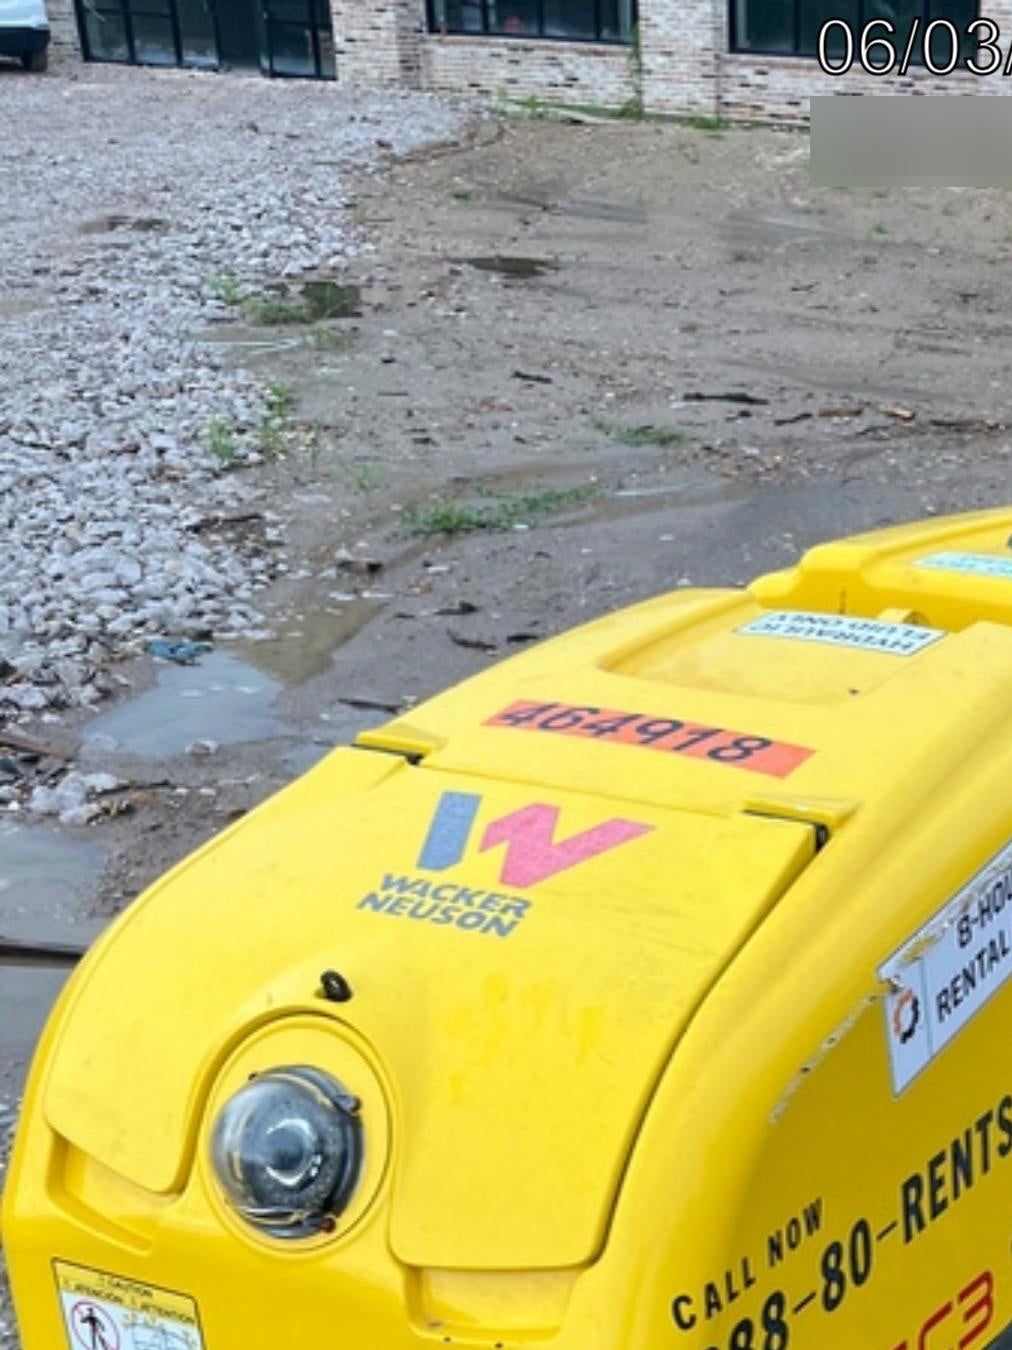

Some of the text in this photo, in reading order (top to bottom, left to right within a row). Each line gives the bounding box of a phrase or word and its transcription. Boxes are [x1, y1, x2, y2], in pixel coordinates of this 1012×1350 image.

[502, 702, 773, 762] 464918
[356, 891, 519, 938] NEUSON
[380, 873, 533, 919] WACKER
[935, 928, 1012, 1024] RENTAL
[671, 1196, 824, 1331] CALL NOW
